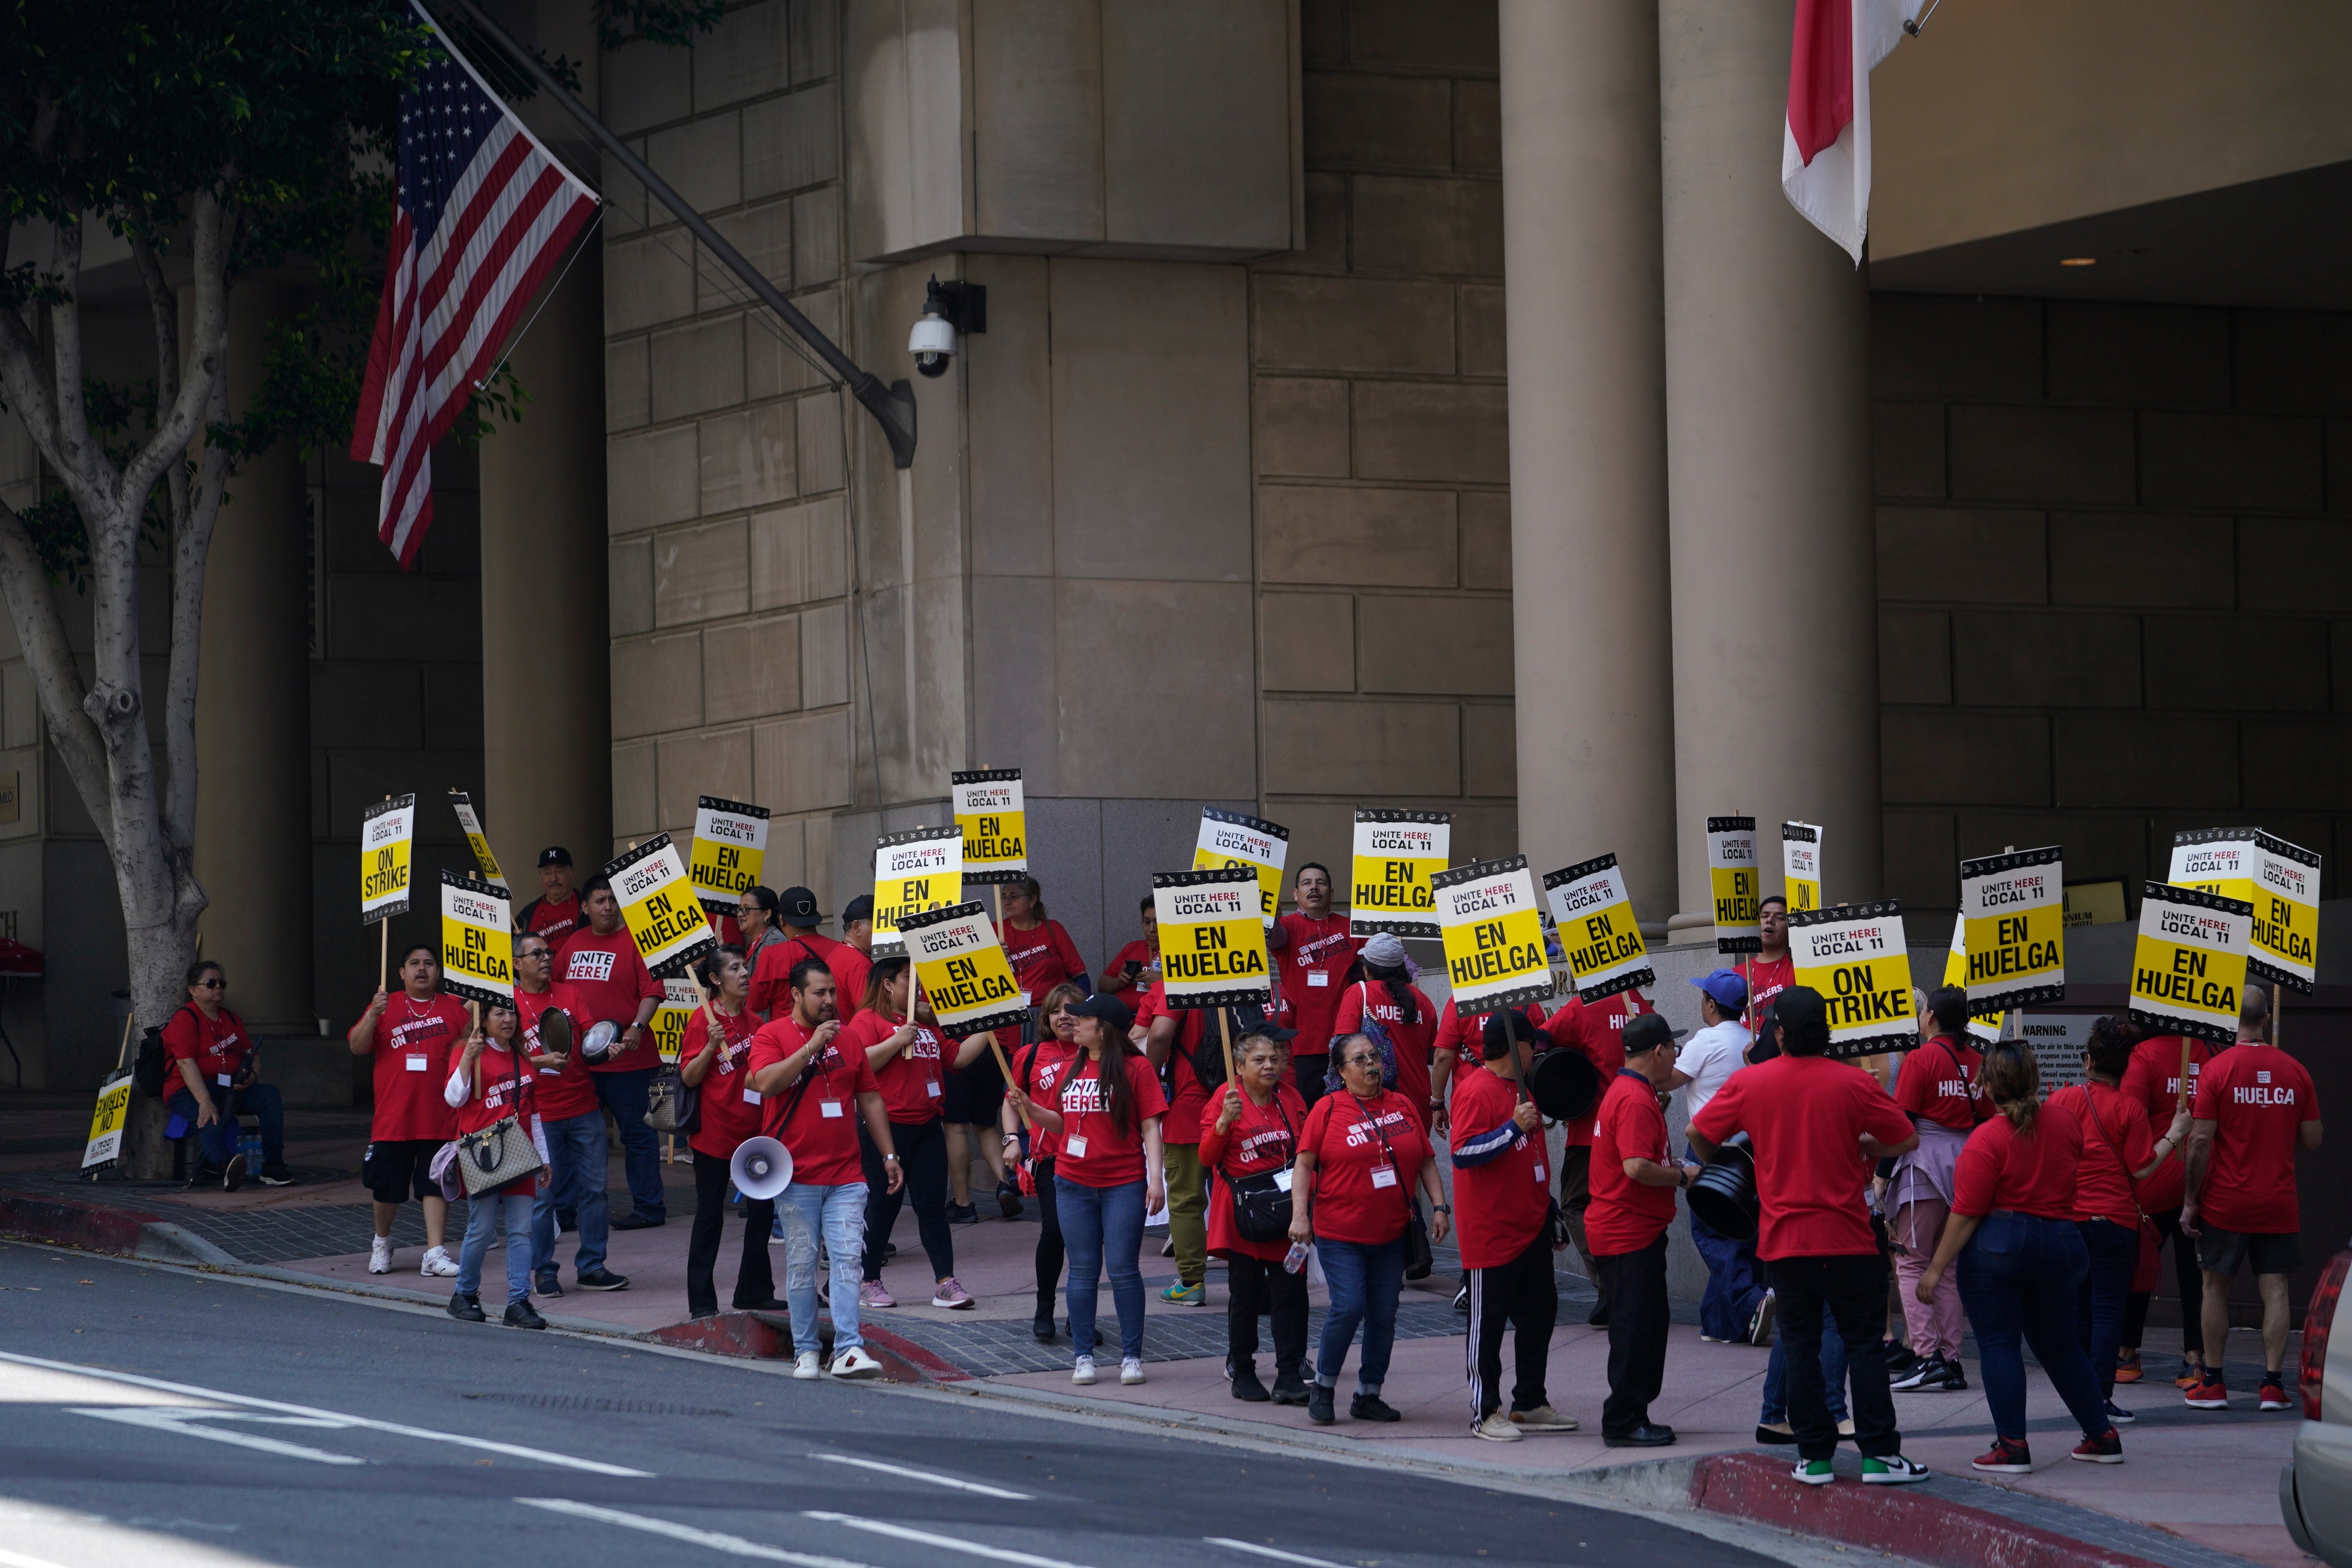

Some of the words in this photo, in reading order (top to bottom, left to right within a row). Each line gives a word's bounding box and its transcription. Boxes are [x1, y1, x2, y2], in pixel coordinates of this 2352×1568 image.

[967, 798, 997, 807] LOCAL
[372, 826, 391, 842] LOCAL
[396, 825, 402, 834] 11
[373, 821, 386, 832] UNITE
[387, 817, 402, 827] HERE!
[710, 825, 741, 839] LOCAL
[746, 832, 754, 842] 11
[712, 817, 733, 828] UNITE
[736, 822, 755, 832] HERE!
[979, 817, 1000, 837] EN
[1218, 829, 1245, 841] UNITE
[1247, 837, 1272, 850] HERE!
[1373, 831, 1401, 839] UNITE
[1404, 831, 1431, 840] HERE!
[1373, 839, 1413, 850] LOCAL
[1420, 841, 1431, 851] 11
[1722, 840, 1739, 849] UNITE
[1740, 840, 1751, 849] HERE!
[718, 846, 740, 869] EN
[893, 850, 917, 861] UNITE
[920, 848, 945, 857] HERE!
[963, 838, 1023, 859] HUELGA
[1215, 837, 1254, 853] LOCAL
[1260, 849, 1270, 858] 11
[1723, 849, 1746, 860] LOCAL
[1747, 850, 1752, 860] 11
[2187, 852, 2212, 862] UNITE
[2215, 850, 2240, 859] HERE!
[378, 847, 394, 872] ON
[892, 858, 929, 871] LOCAL
[935, 856, 945, 866] 11
[1792, 858, 1806, 871] LOCAL
[1808, 862, 1813, 872] 11
[2185, 861, 2222, 872] LOCAL
[2228, 859, 2239, 870] 11
[366, 865, 407, 898] STRIKE
[623, 869, 644, 886] UNITE
[645, 859, 666, 875] HERE!
[627, 874, 658, 895] LOCAL
[660, 866, 670, 879] 11
[692, 863, 755, 892] HUELGA
[1386, 862, 1414, 883] EN
[2264, 859, 2283, 874] UNITE
[2284, 869, 2305, 883] HERE!
[904, 879, 929, 902] EN
[1564, 886, 1588, 901] UNITE
[1590, 880, 1610, 893] HERE!
[1734, 872, 1749, 896] EN
[1982, 881, 2012, 895] UNITE
[2015, 876, 2044, 889] HERE!
[2264, 869, 2292, 890] LOCAL
[2296, 883, 2304, 895] 11
[454, 895, 474, 907] UNITE
[476, 903, 496, 913] HERE!
[1175, 894, 1206, 904] UNITE
[1209, 892, 1239, 901] HERE!
[1453, 889, 1482, 904] UNITE
[1485, 883, 1513, 897] HERE!
[1454, 897, 1497, 915] LOCAL
[1503, 893, 1515, 905] 11
[1567, 892, 1601, 912] LOCAL
[1604, 888, 1614, 899] 11
[1798, 883, 1810, 909] ON
[1983, 890, 2026, 907] LOCAL
[2032, 886, 2044, 899] 11
[454, 903, 484, 919] LOCAL
[489, 913, 497, 923] 11
[645, 892, 673, 921] EN
[1175, 902, 1222, 915] LOCAL
[1229, 901, 1241, 912] 11
[1717, 898, 1760, 921] HUELGA
[2271, 898, 2291, 928] EN
[538, 918, 574, 938] WORKERS
[635, 905, 704, 953] HUELGA
[1586, 914, 1613, 942] EN
[1998, 916, 2028, 946] EN
[2163, 910, 2196, 924] UNITE
[2198, 917, 2230, 932] HERE!
[465, 927, 486, 952] EN
[920, 930, 948, 944] UNITE
[948, 924, 975, 937] HERE!
[1195, 926, 1227, 950] EN
[1474, 921, 1506, 950] EN
[1812, 932, 1846, 945] UNITE
[1849, 927, 1882, 940] HERE!
[2161, 920, 2209, 939] LOCAL
[2217, 932, 2229, 944] 11
[2252, 916, 2312, 963] HUELGA
[923, 936, 964, 953] LOCAL
[967, 933, 980, 944] 11
[1570, 932, 1643, 974] HUELGA
[1813, 940, 1863, 957] LOCAL
[1870, 938, 1884, 950] 11
[446, 944, 510, 981] HUELGA
[572, 952, 614, 966] UNITE
[1165, 950, 1264, 978] HUELGA
[1297, 953, 1314, 967] ON
[1451, 942, 1543, 984] HUELGA
[1970, 940, 2060, 980] HUELGA
[2173, 948, 2207, 978] EN
[567, 966, 609, 979] HERE!
[945, 957, 978, 983] EN
[1833, 965, 1873, 996] ON
[667, 993, 685, 1002] CAL
[691, 994, 698, 1003] 11
[929, 975, 1016, 1011] HUELGA
[2136, 968, 2236, 1012] HUELGA
[1376, 1004, 1423, 1025] HUEA
[1825, 989, 1909, 1025] TRIKE
[402, 1016, 443, 1031] WORKERS
[664, 1011, 688, 1031] ON
[2022, 1025, 2066, 1036] WARNING
[391, 1034, 407, 1049] ON
[719, 1061, 734, 1075] ON
[1039, 1074, 1055, 1090] ON
[96, 1088, 127, 1118] STRIKE
[485, 1094, 503, 1109] ON
[2234, 1087, 2295, 1106] HUELGA
[99, 1111, 114, 1134] ON
[1346, 1132, 1368, 1147] ON
[1240, 1149, 1258, 1163] ON
